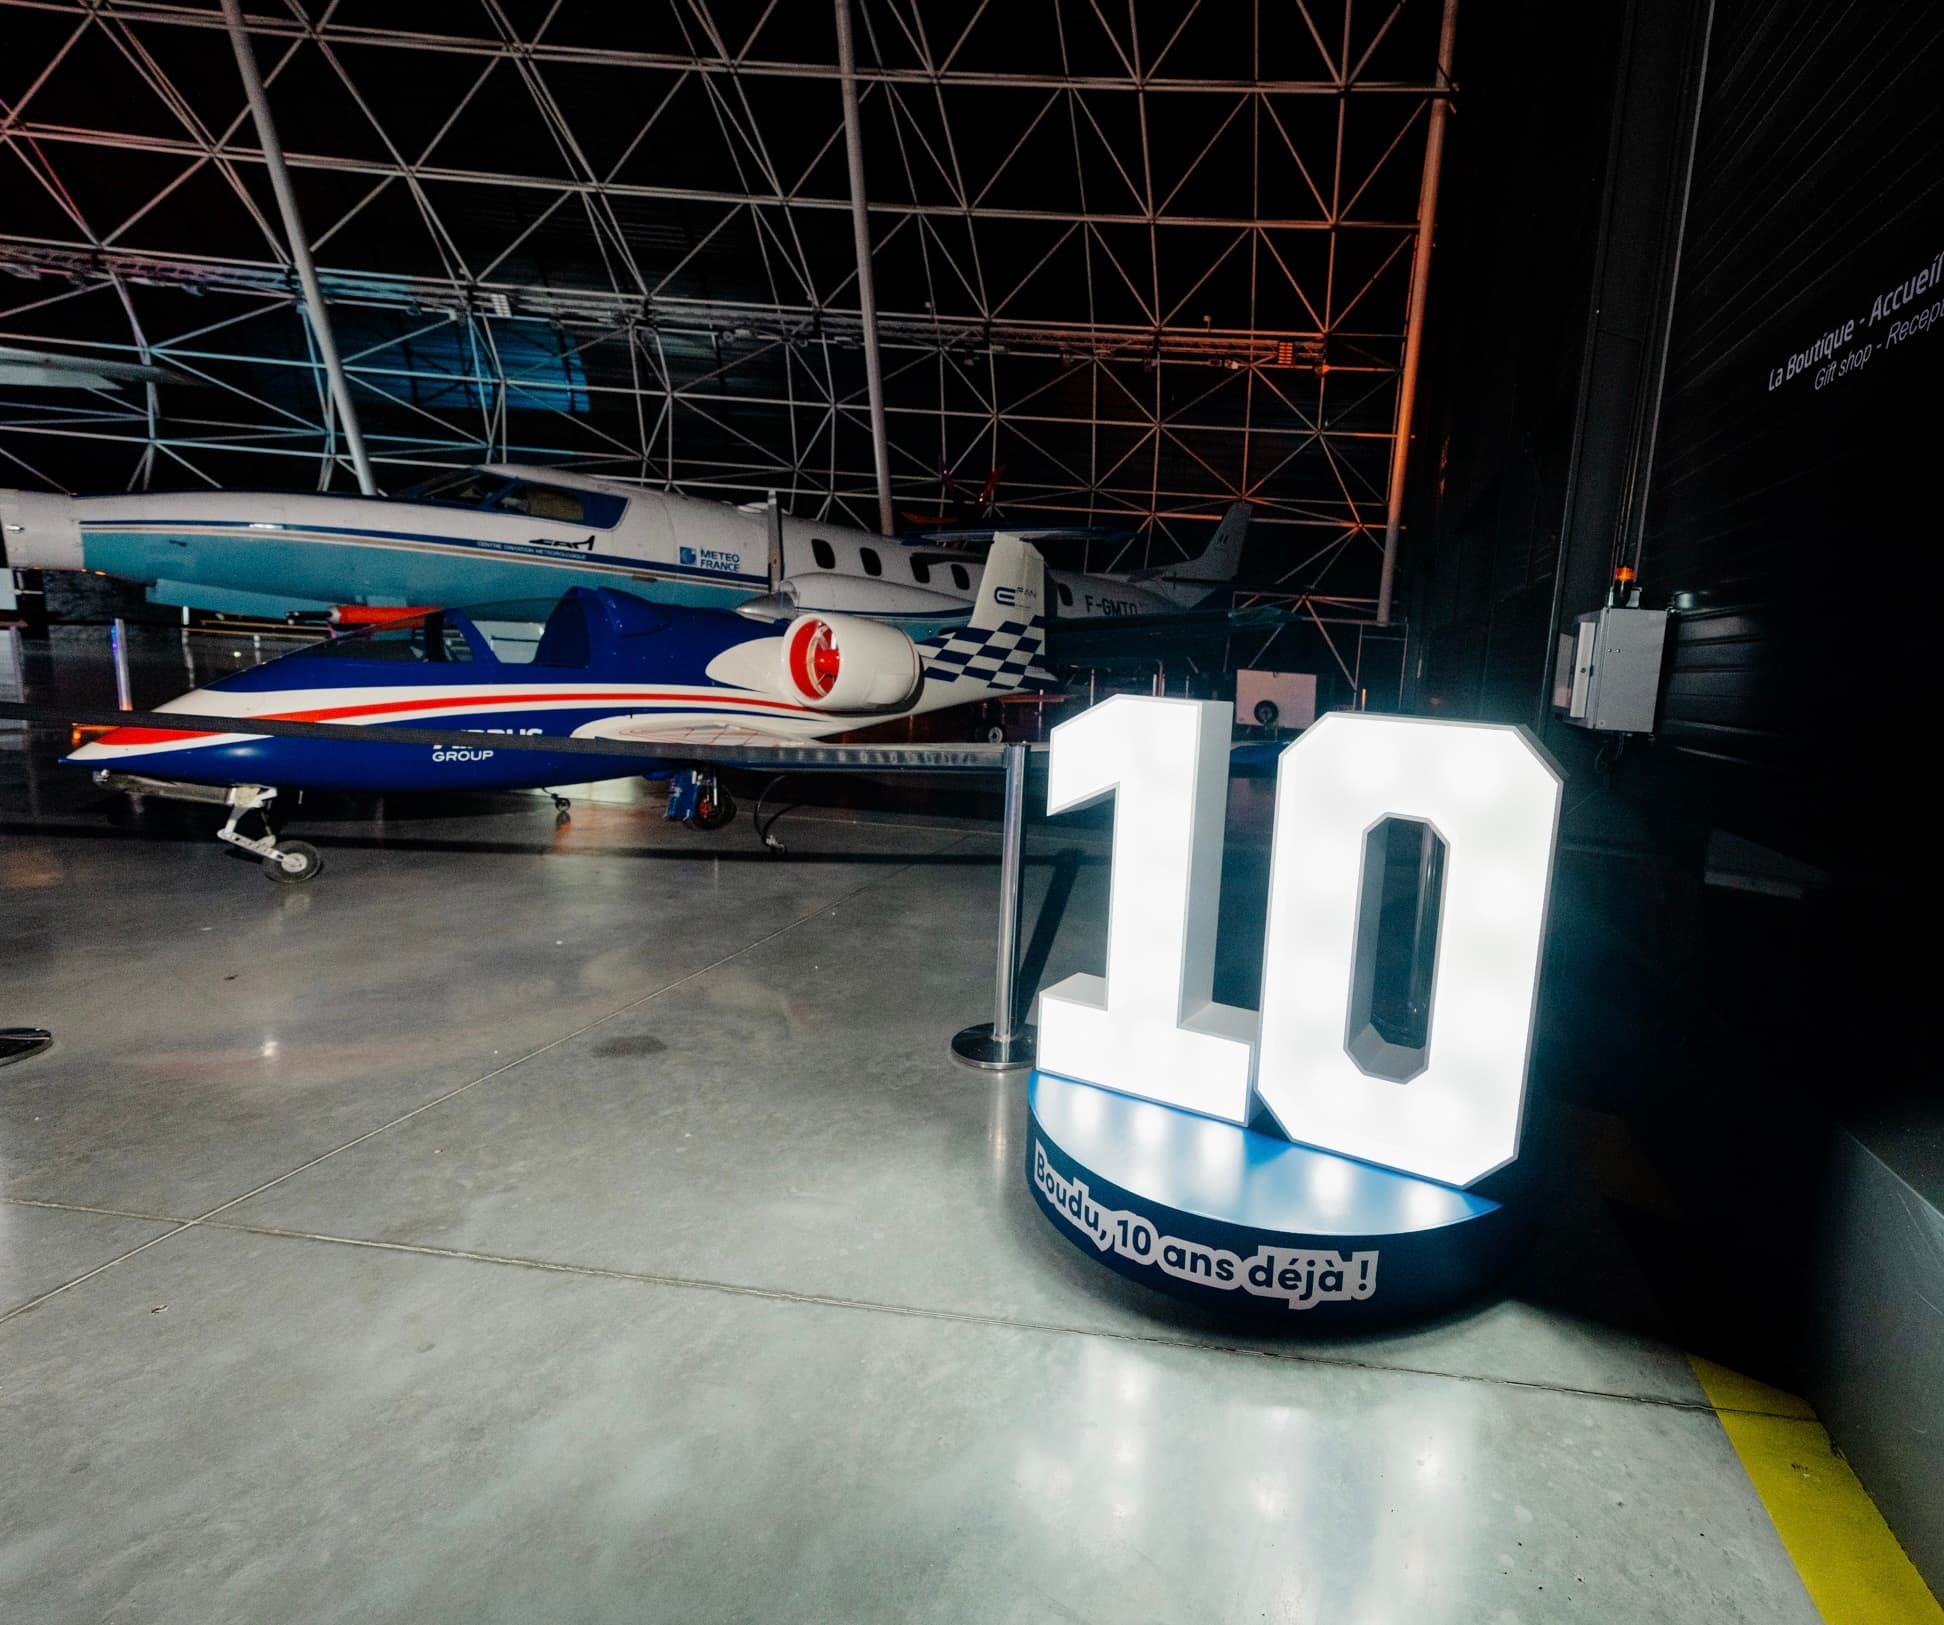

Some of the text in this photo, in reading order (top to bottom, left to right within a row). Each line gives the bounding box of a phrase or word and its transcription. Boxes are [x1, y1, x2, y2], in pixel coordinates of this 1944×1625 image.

[1768, 368, 1783, 391] La
[1786, 318, 1855, 381] Boutique
[1868, 250, 1944, 327] Accueil
[1814, 360, 1837, 391] Gift
[1838, 343, 1873, 377] shop
[700, 548, 740, 563] METEO
[700, 558, 740, 572] FRANCE
[432, 750, 494, 762] GROUP
[1035, 694, 1565, 1191] 10
[1035, 1149, 1370, 1302] Boudu, 10 ans déjà !
